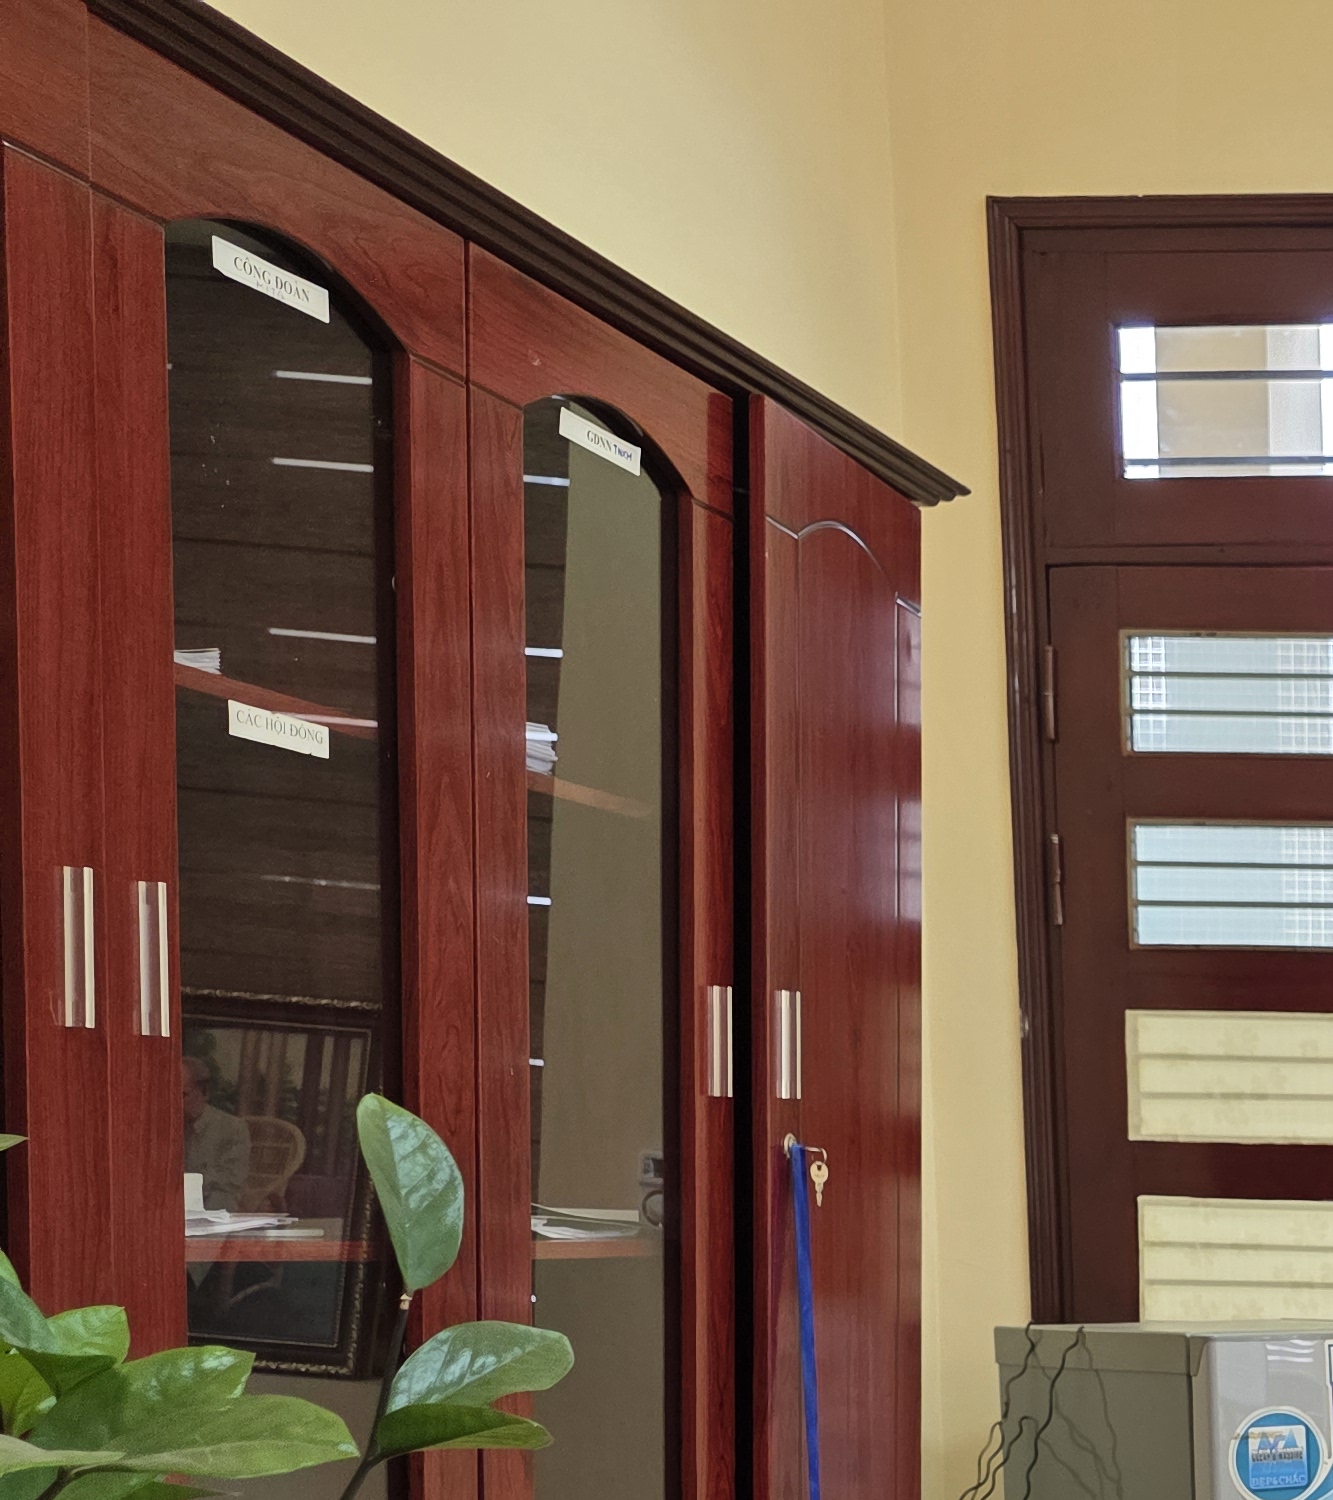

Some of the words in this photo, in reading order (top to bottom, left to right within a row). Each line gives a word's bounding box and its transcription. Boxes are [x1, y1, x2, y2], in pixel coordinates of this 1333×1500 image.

[234, 256, 271, 285] CÔNG
[275, 275, 309, 302] ĐOÀN
[587, 430, 612, 452] GDNN
[236, 708, 262, 729] CÁC
[265, 716, 286, 735] HỘI
[290, 723, 323, 745] ĐỒNG
